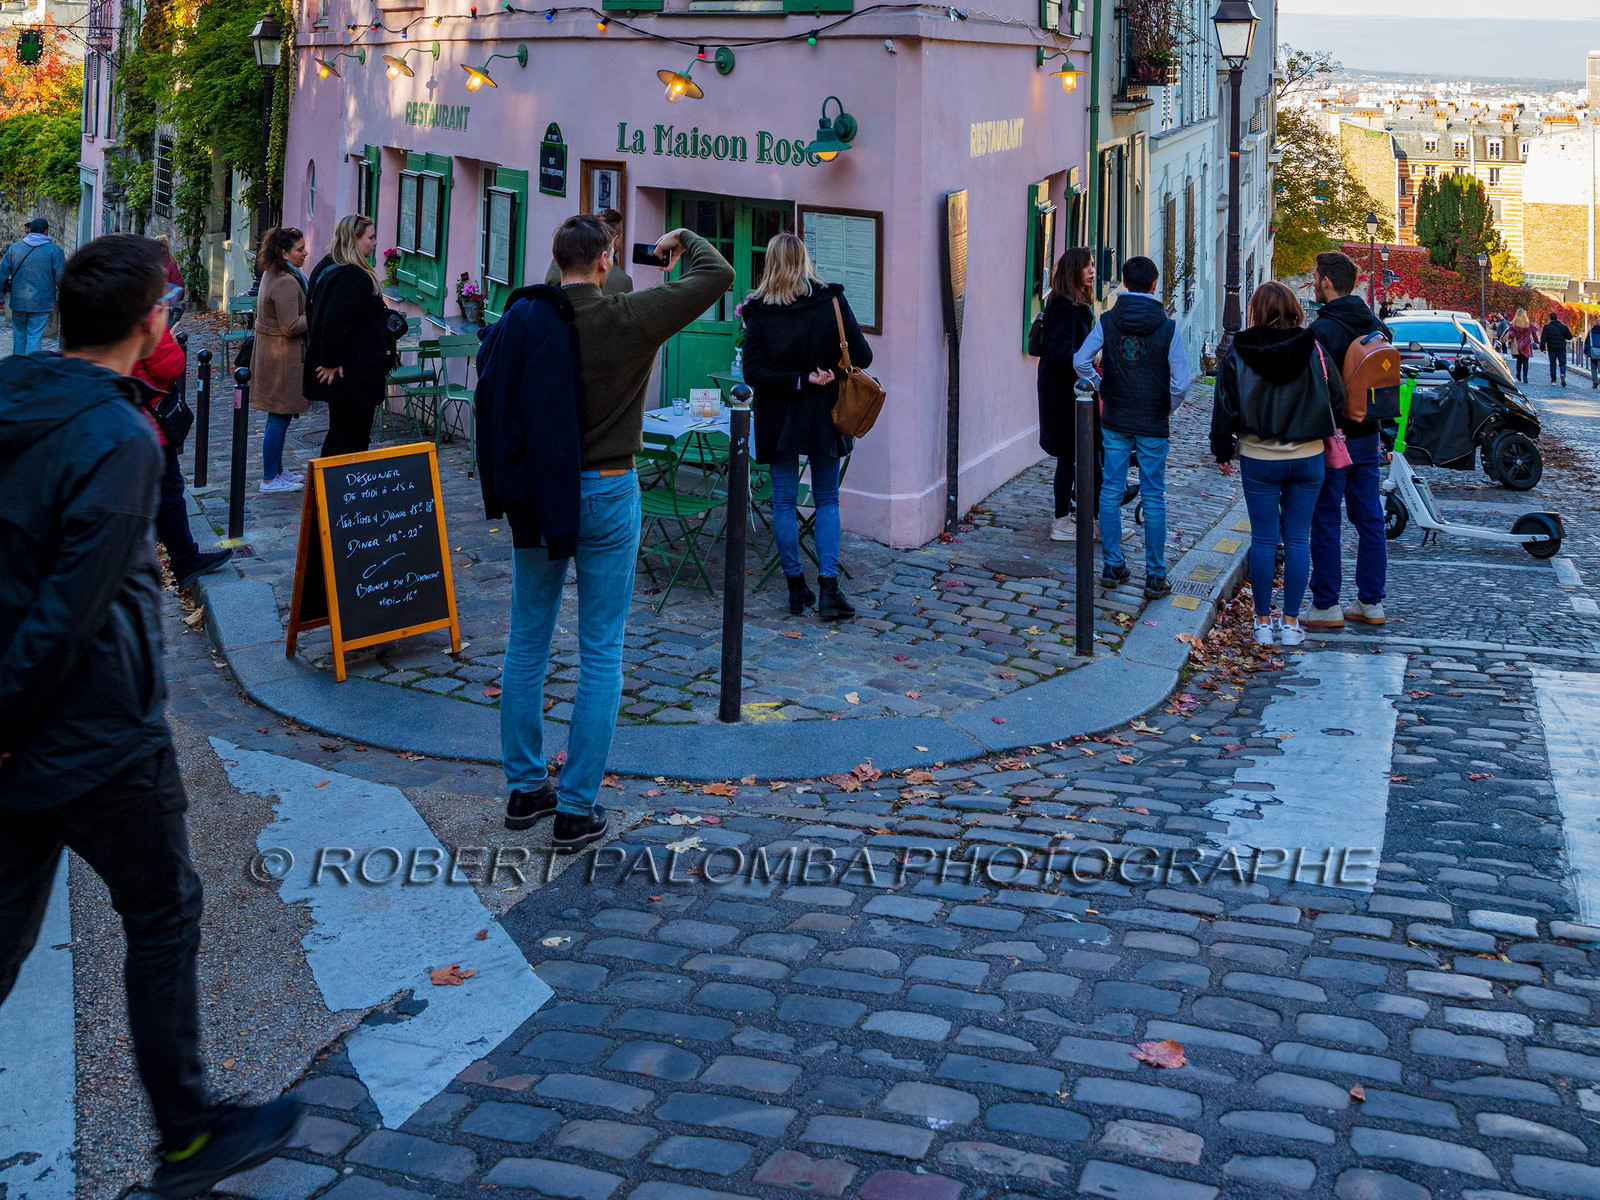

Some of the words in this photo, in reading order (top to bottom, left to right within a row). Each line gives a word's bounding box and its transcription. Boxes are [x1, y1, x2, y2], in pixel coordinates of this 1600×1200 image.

[405, 101, 471, 132] RESTAURANT
[616, 122, 646, 154] La
[653, 125, 748, 162] Maison
[971, 118, 1024, 158] RESTAURANT
